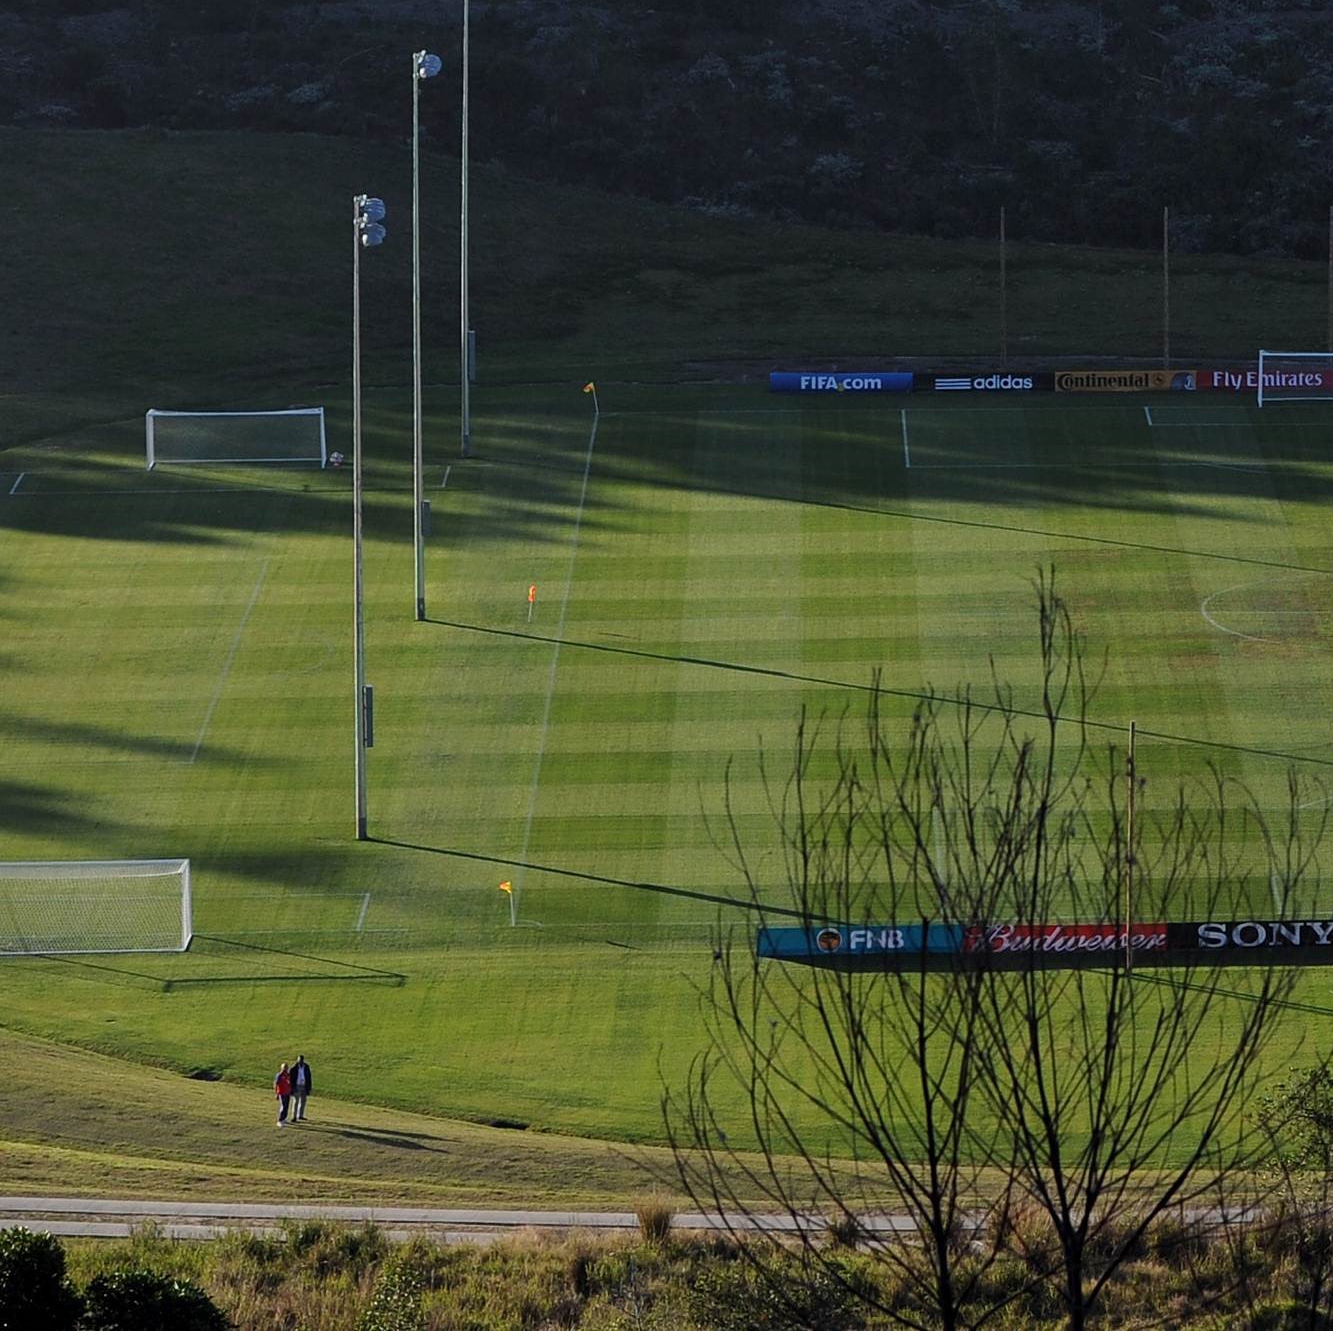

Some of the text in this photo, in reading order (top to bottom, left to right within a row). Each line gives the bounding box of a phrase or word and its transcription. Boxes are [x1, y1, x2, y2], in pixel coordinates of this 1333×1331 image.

[800, 376, 882, 390] FIFA.com
[973, 375, 1033, 390] adidas
[1057, 372, 1149, 389] Continental
[1213, 371, 1323, 390] Fly Emirates
[849, 929, 905, 950] FNB
[988, 924, 1167, 953] Budweiser
